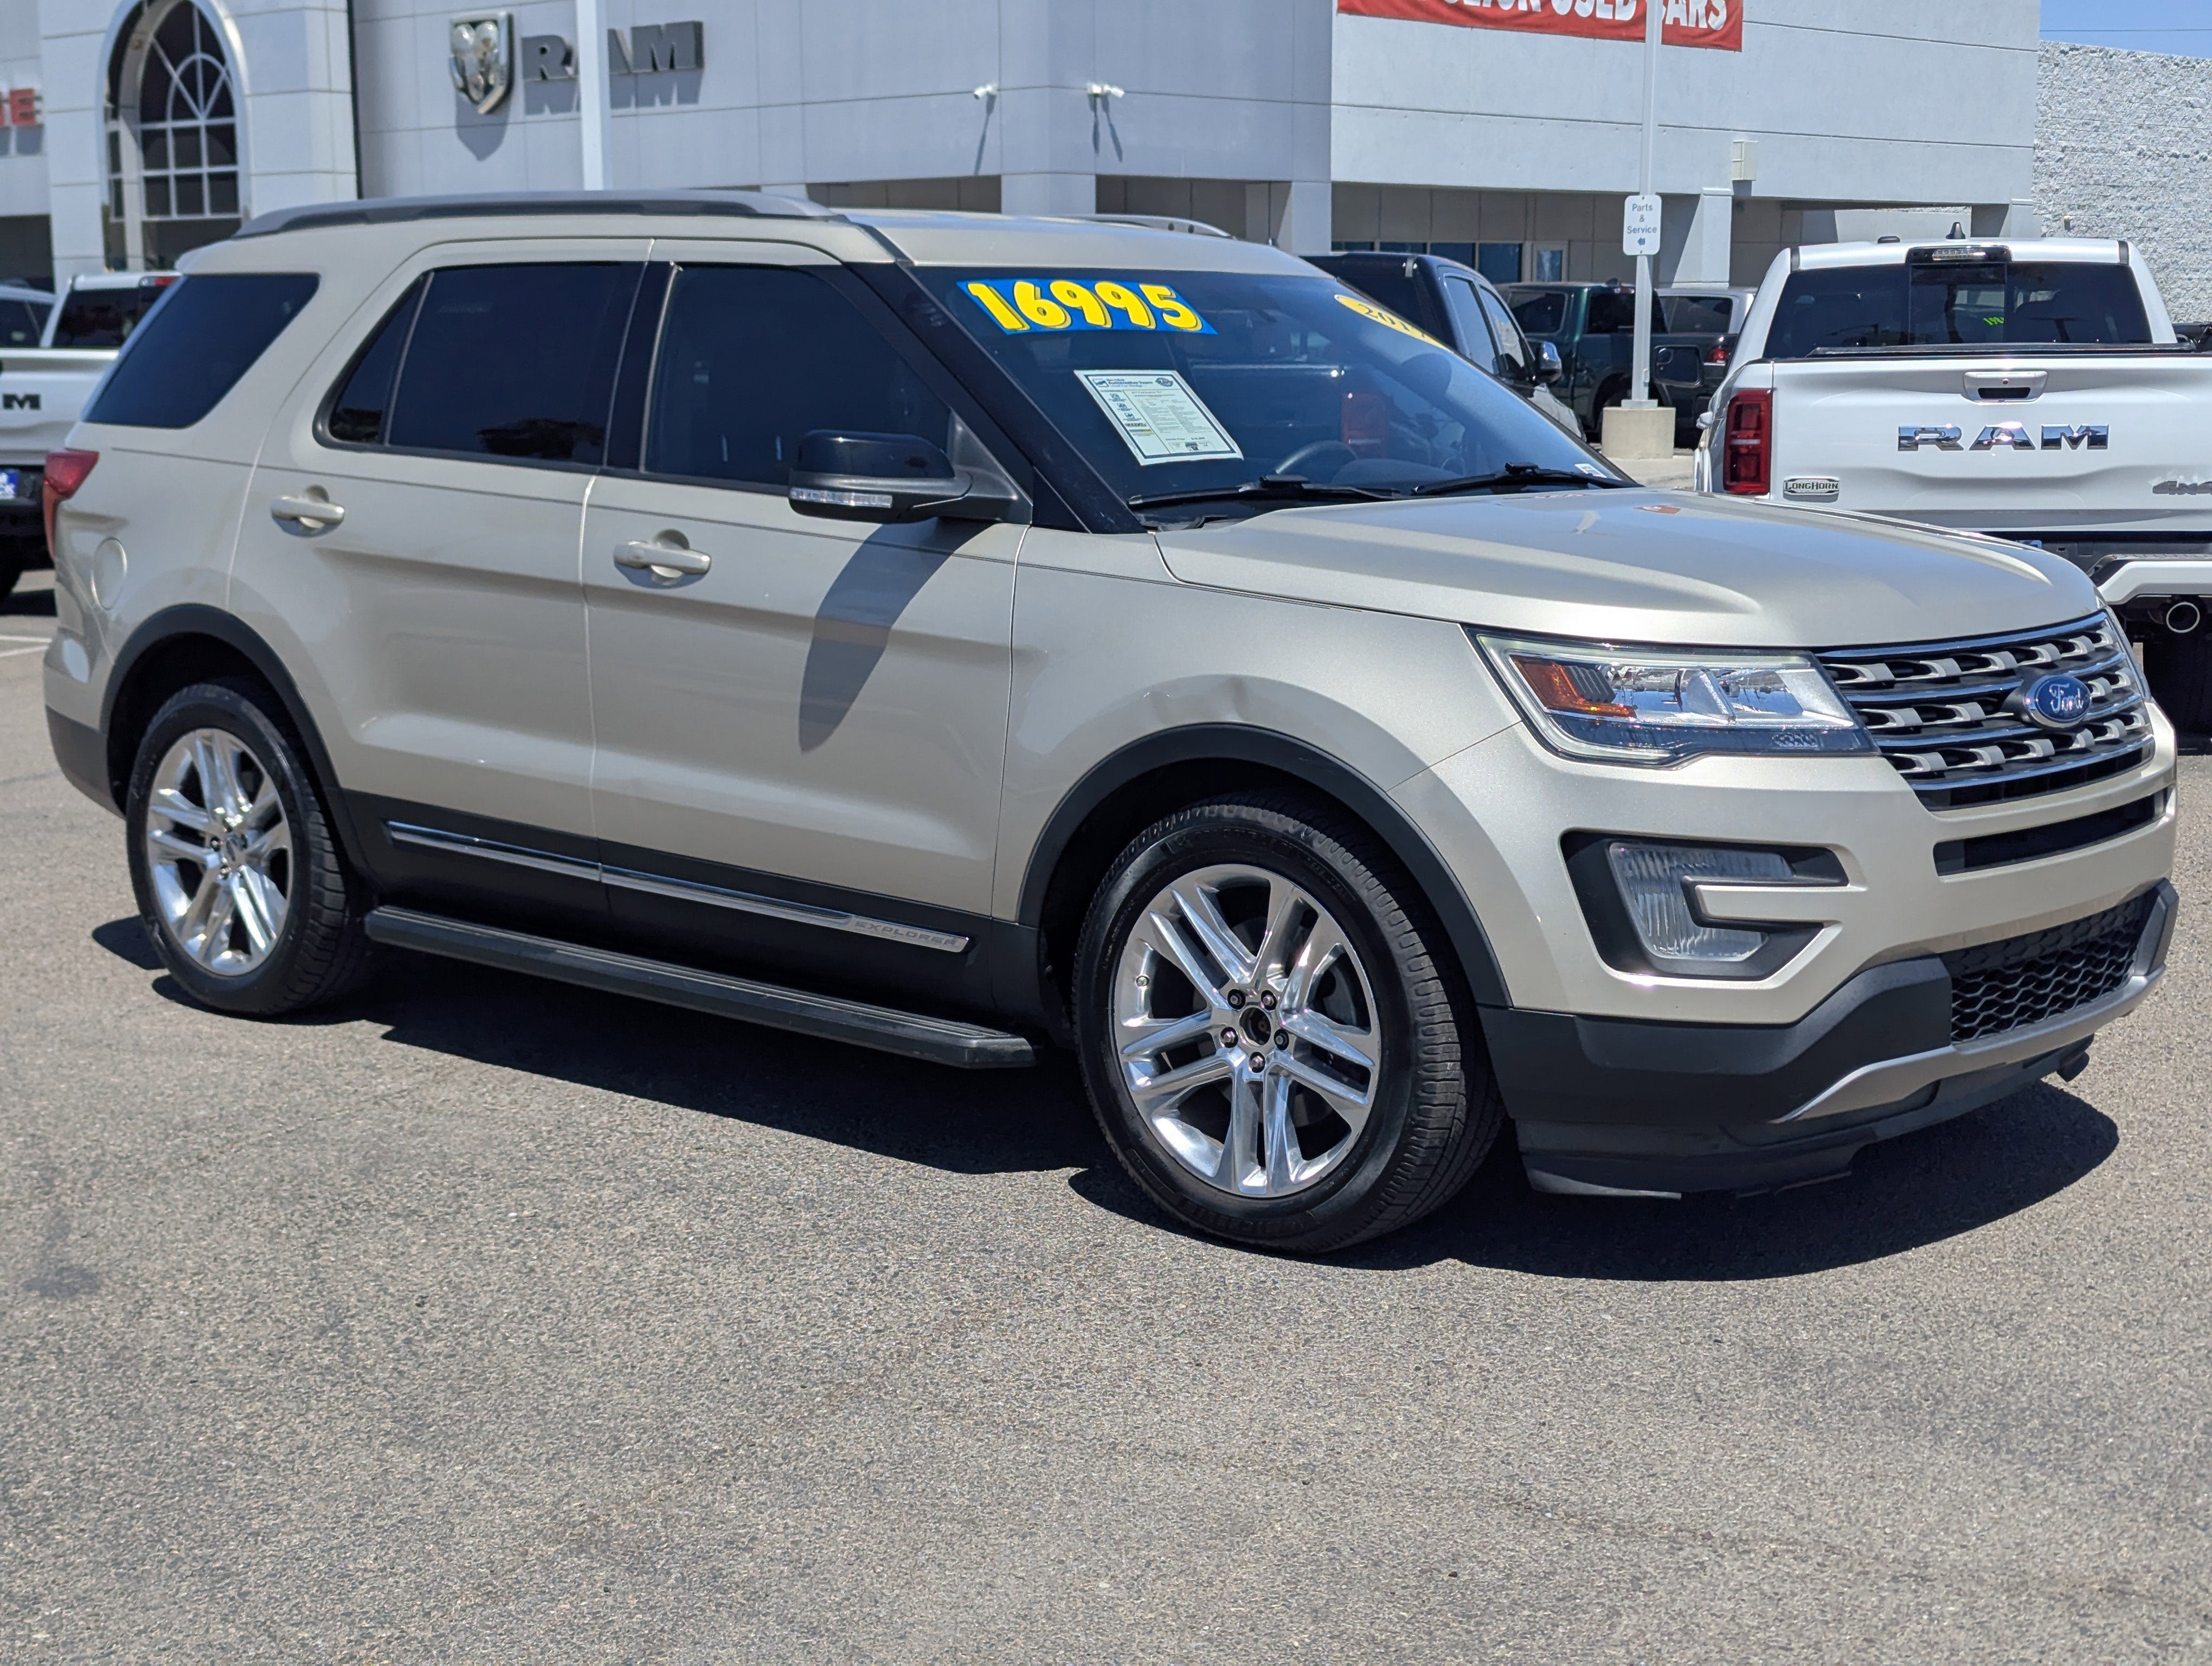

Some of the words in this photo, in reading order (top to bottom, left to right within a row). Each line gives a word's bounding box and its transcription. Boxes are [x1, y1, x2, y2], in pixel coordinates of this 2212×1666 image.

[1659, 0, 1728, 30] ARS
[0, 88, 40, 128] E
[1632, 203, 1653, 212] Parts
[1639, 214, 1645, 222] &
[1626, 226, 1657, 234] Service
[967, 280, 1202, 331] 16995
[1358, 303, 1426, 339] 201
[1898, 422, 2110, 451] RAM
[2049, 683, 2084, 712] Ford
[854, 921, 957, 946] EXPLORER
